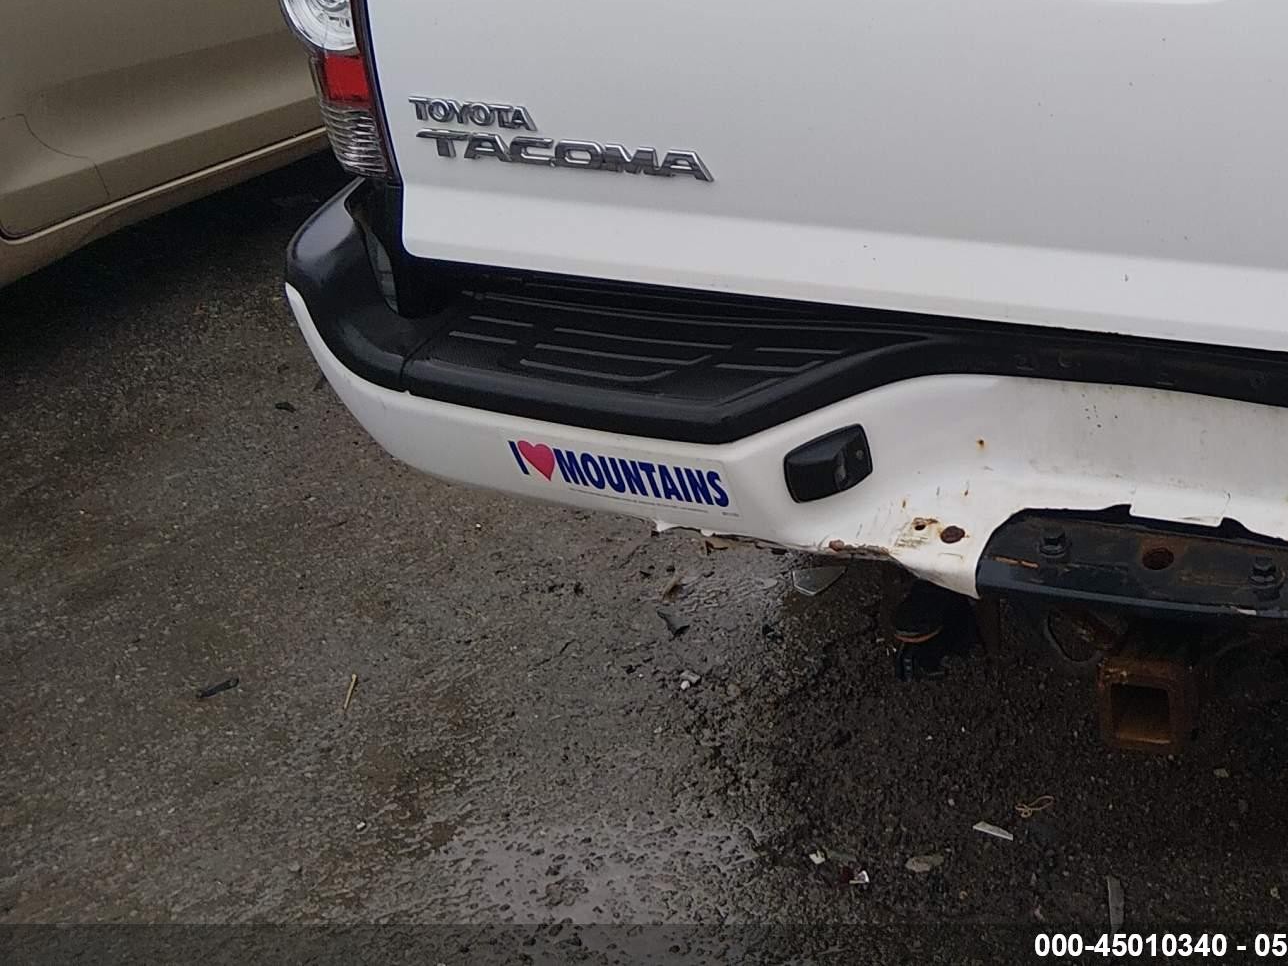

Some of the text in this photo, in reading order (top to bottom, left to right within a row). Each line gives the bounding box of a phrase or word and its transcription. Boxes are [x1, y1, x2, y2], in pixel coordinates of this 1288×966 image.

[408, 95, 537, 132] TOYOTA
[416, 128, 714, 182] TACOMA
[508, 440, 530, 475] I
[554, 448, 729, 507] MOUNTAINS
